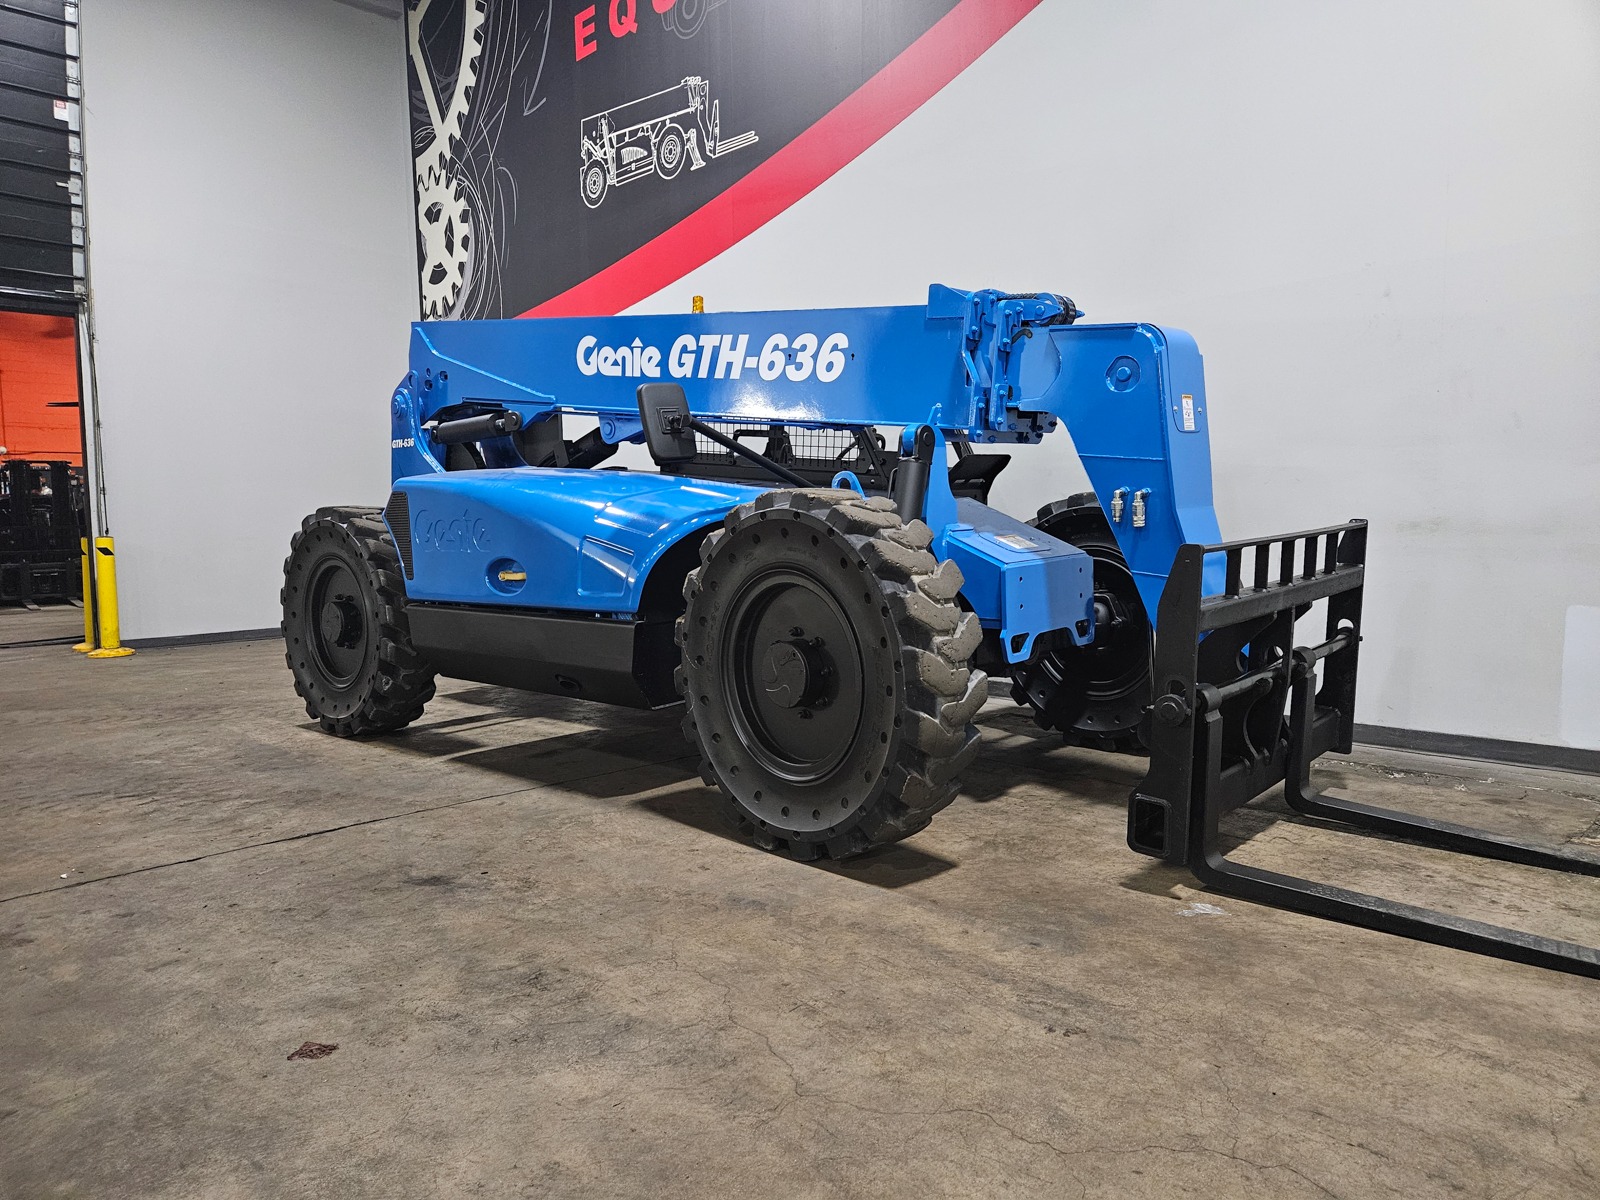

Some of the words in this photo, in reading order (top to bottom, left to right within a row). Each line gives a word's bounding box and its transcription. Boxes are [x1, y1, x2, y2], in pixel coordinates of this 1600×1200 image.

[574, 0, 677, 62] EQ
[576, 335, 662, 378] Genie
[668, 332, 849, 383] GTH-636
[391, 438, 415, 449] GTH-636
[414, 508, 492, 553] Genie
